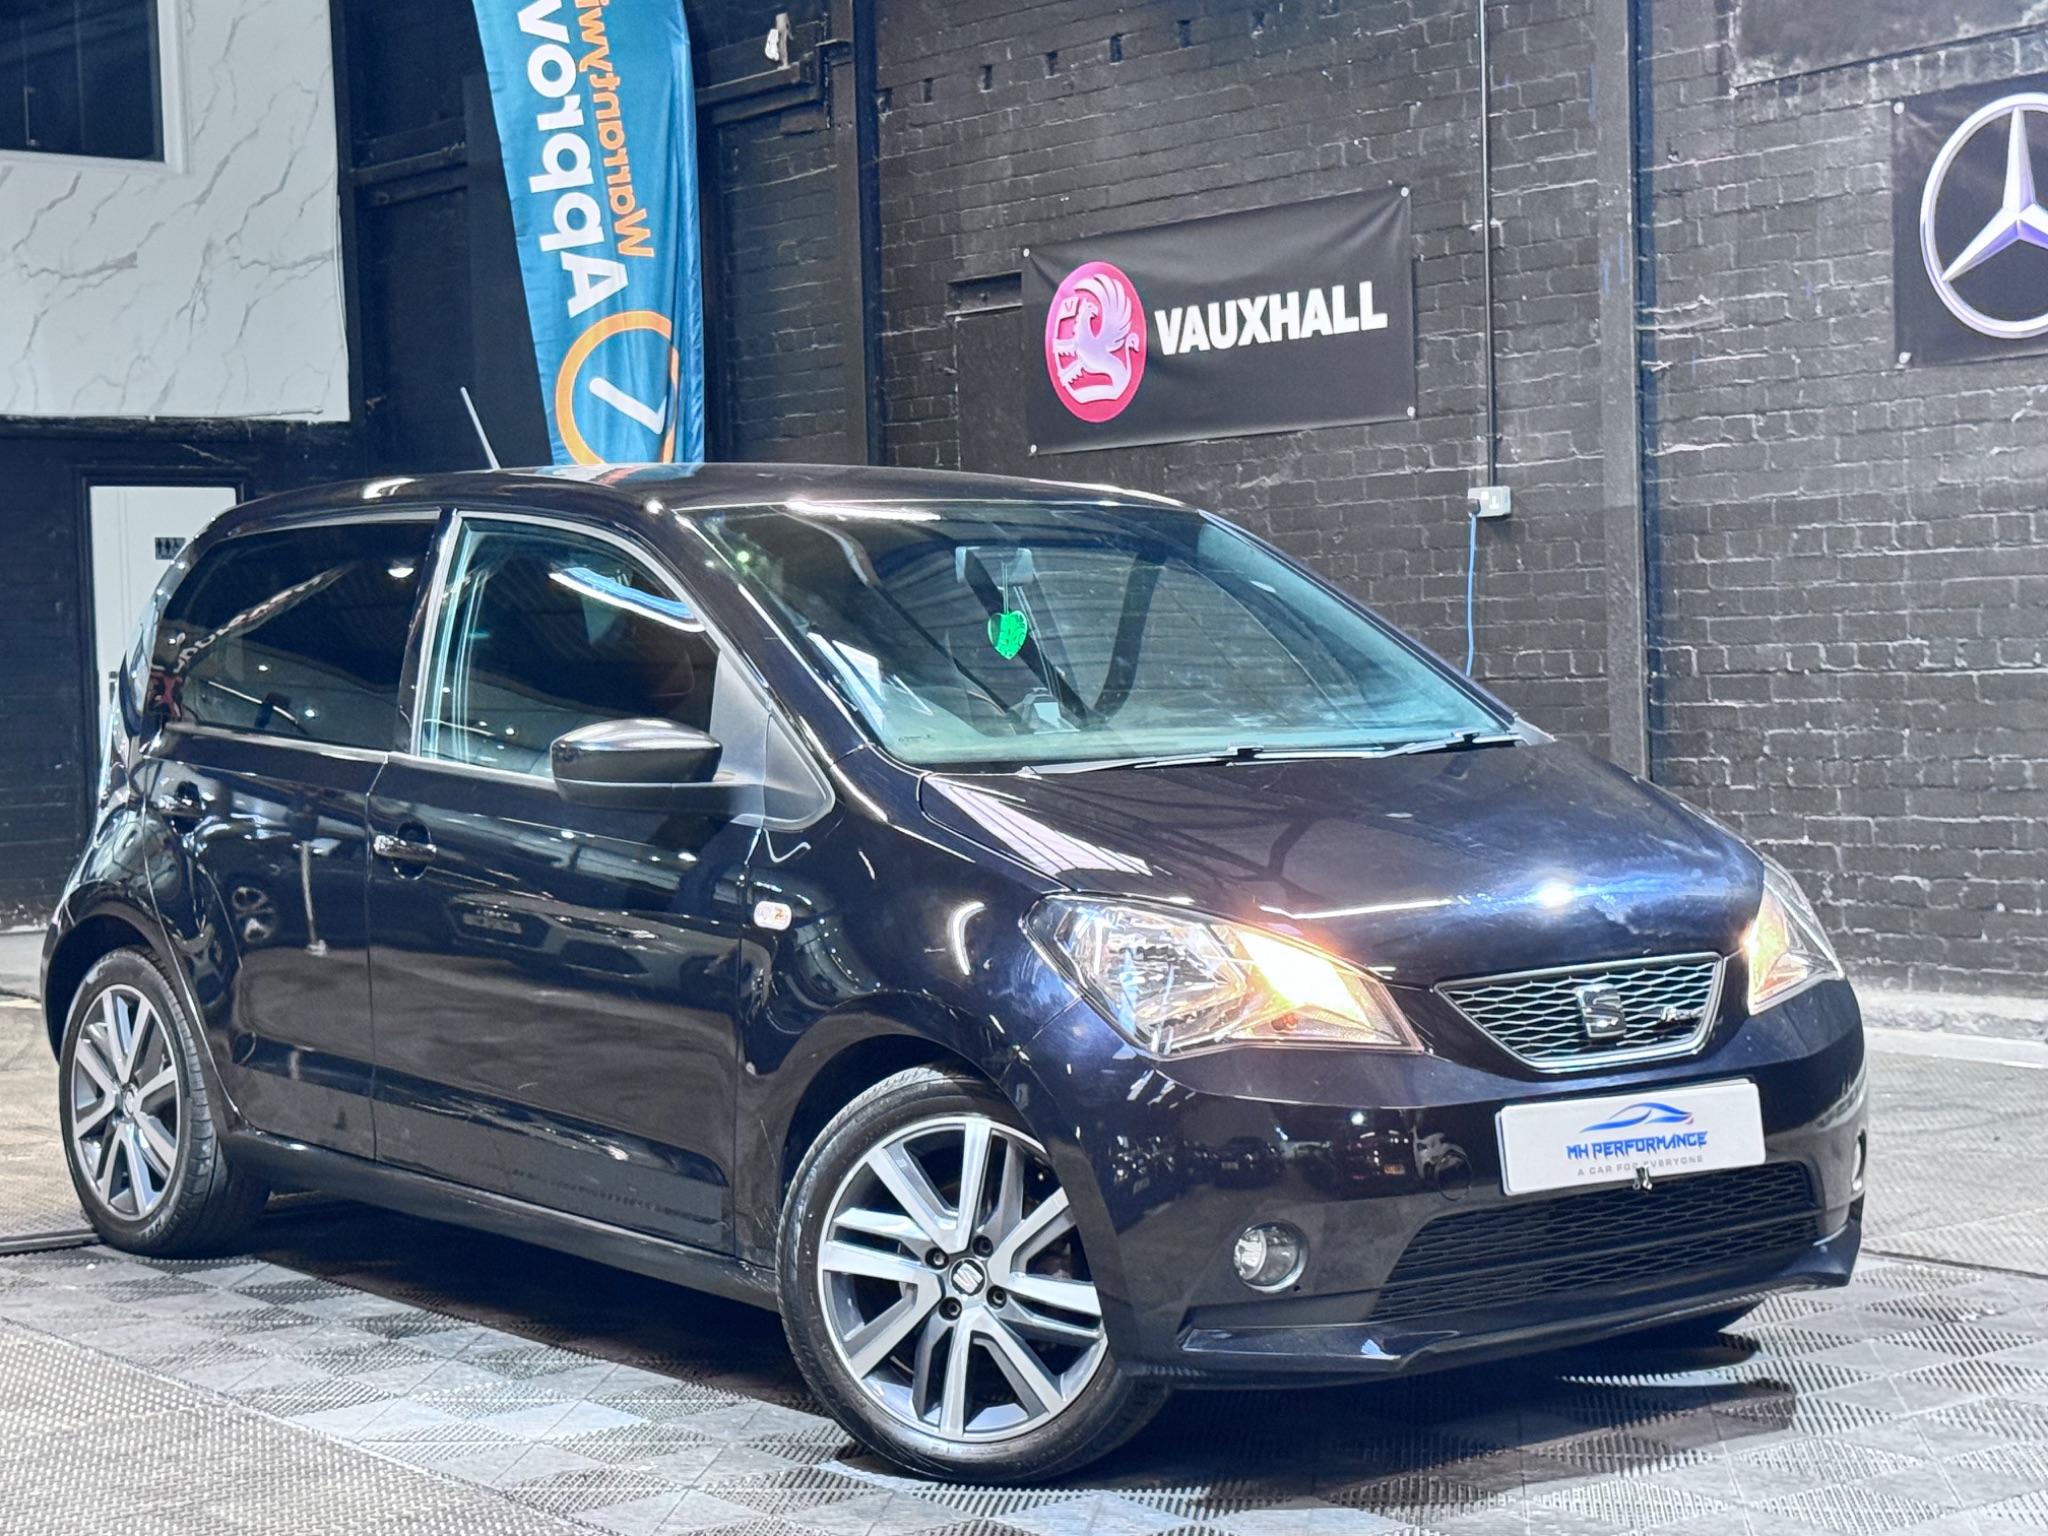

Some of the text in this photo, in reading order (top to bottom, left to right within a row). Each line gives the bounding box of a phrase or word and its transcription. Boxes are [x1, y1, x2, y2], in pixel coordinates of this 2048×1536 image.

[1154, 280, 1389, 356] VAUXHALL
[1566, 1132, 1707, 1160] MH PERFORMANCE
[1577, 1168, 1585, 1177] A
[1589, 1165, 1613, 1176] CAR
